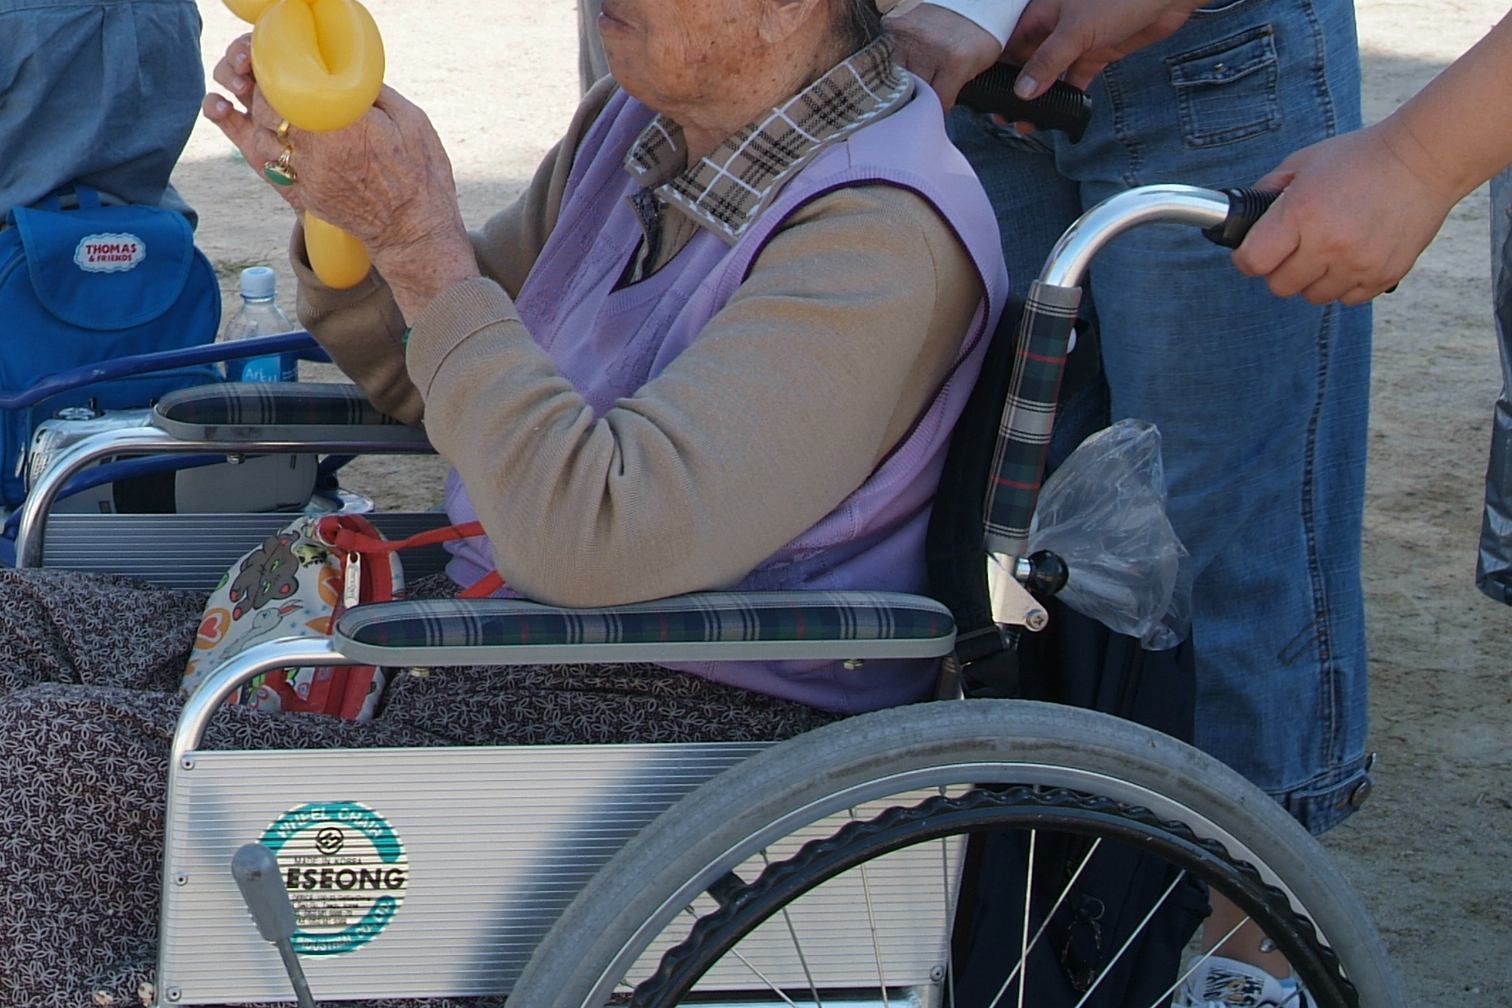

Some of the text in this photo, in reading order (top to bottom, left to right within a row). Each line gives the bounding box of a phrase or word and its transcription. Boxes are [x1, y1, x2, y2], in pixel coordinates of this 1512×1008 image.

[85, 243, 138, 254] THOMAS
[88, 254, 133, 263] & FRIENDS
[277, 807, 383, 838] WHEEL CHAIR
[294, 857, 317, 865] MADE
[334, 856, 363, 865] KOREA
[286, 868, 406, 891] ESEONG
